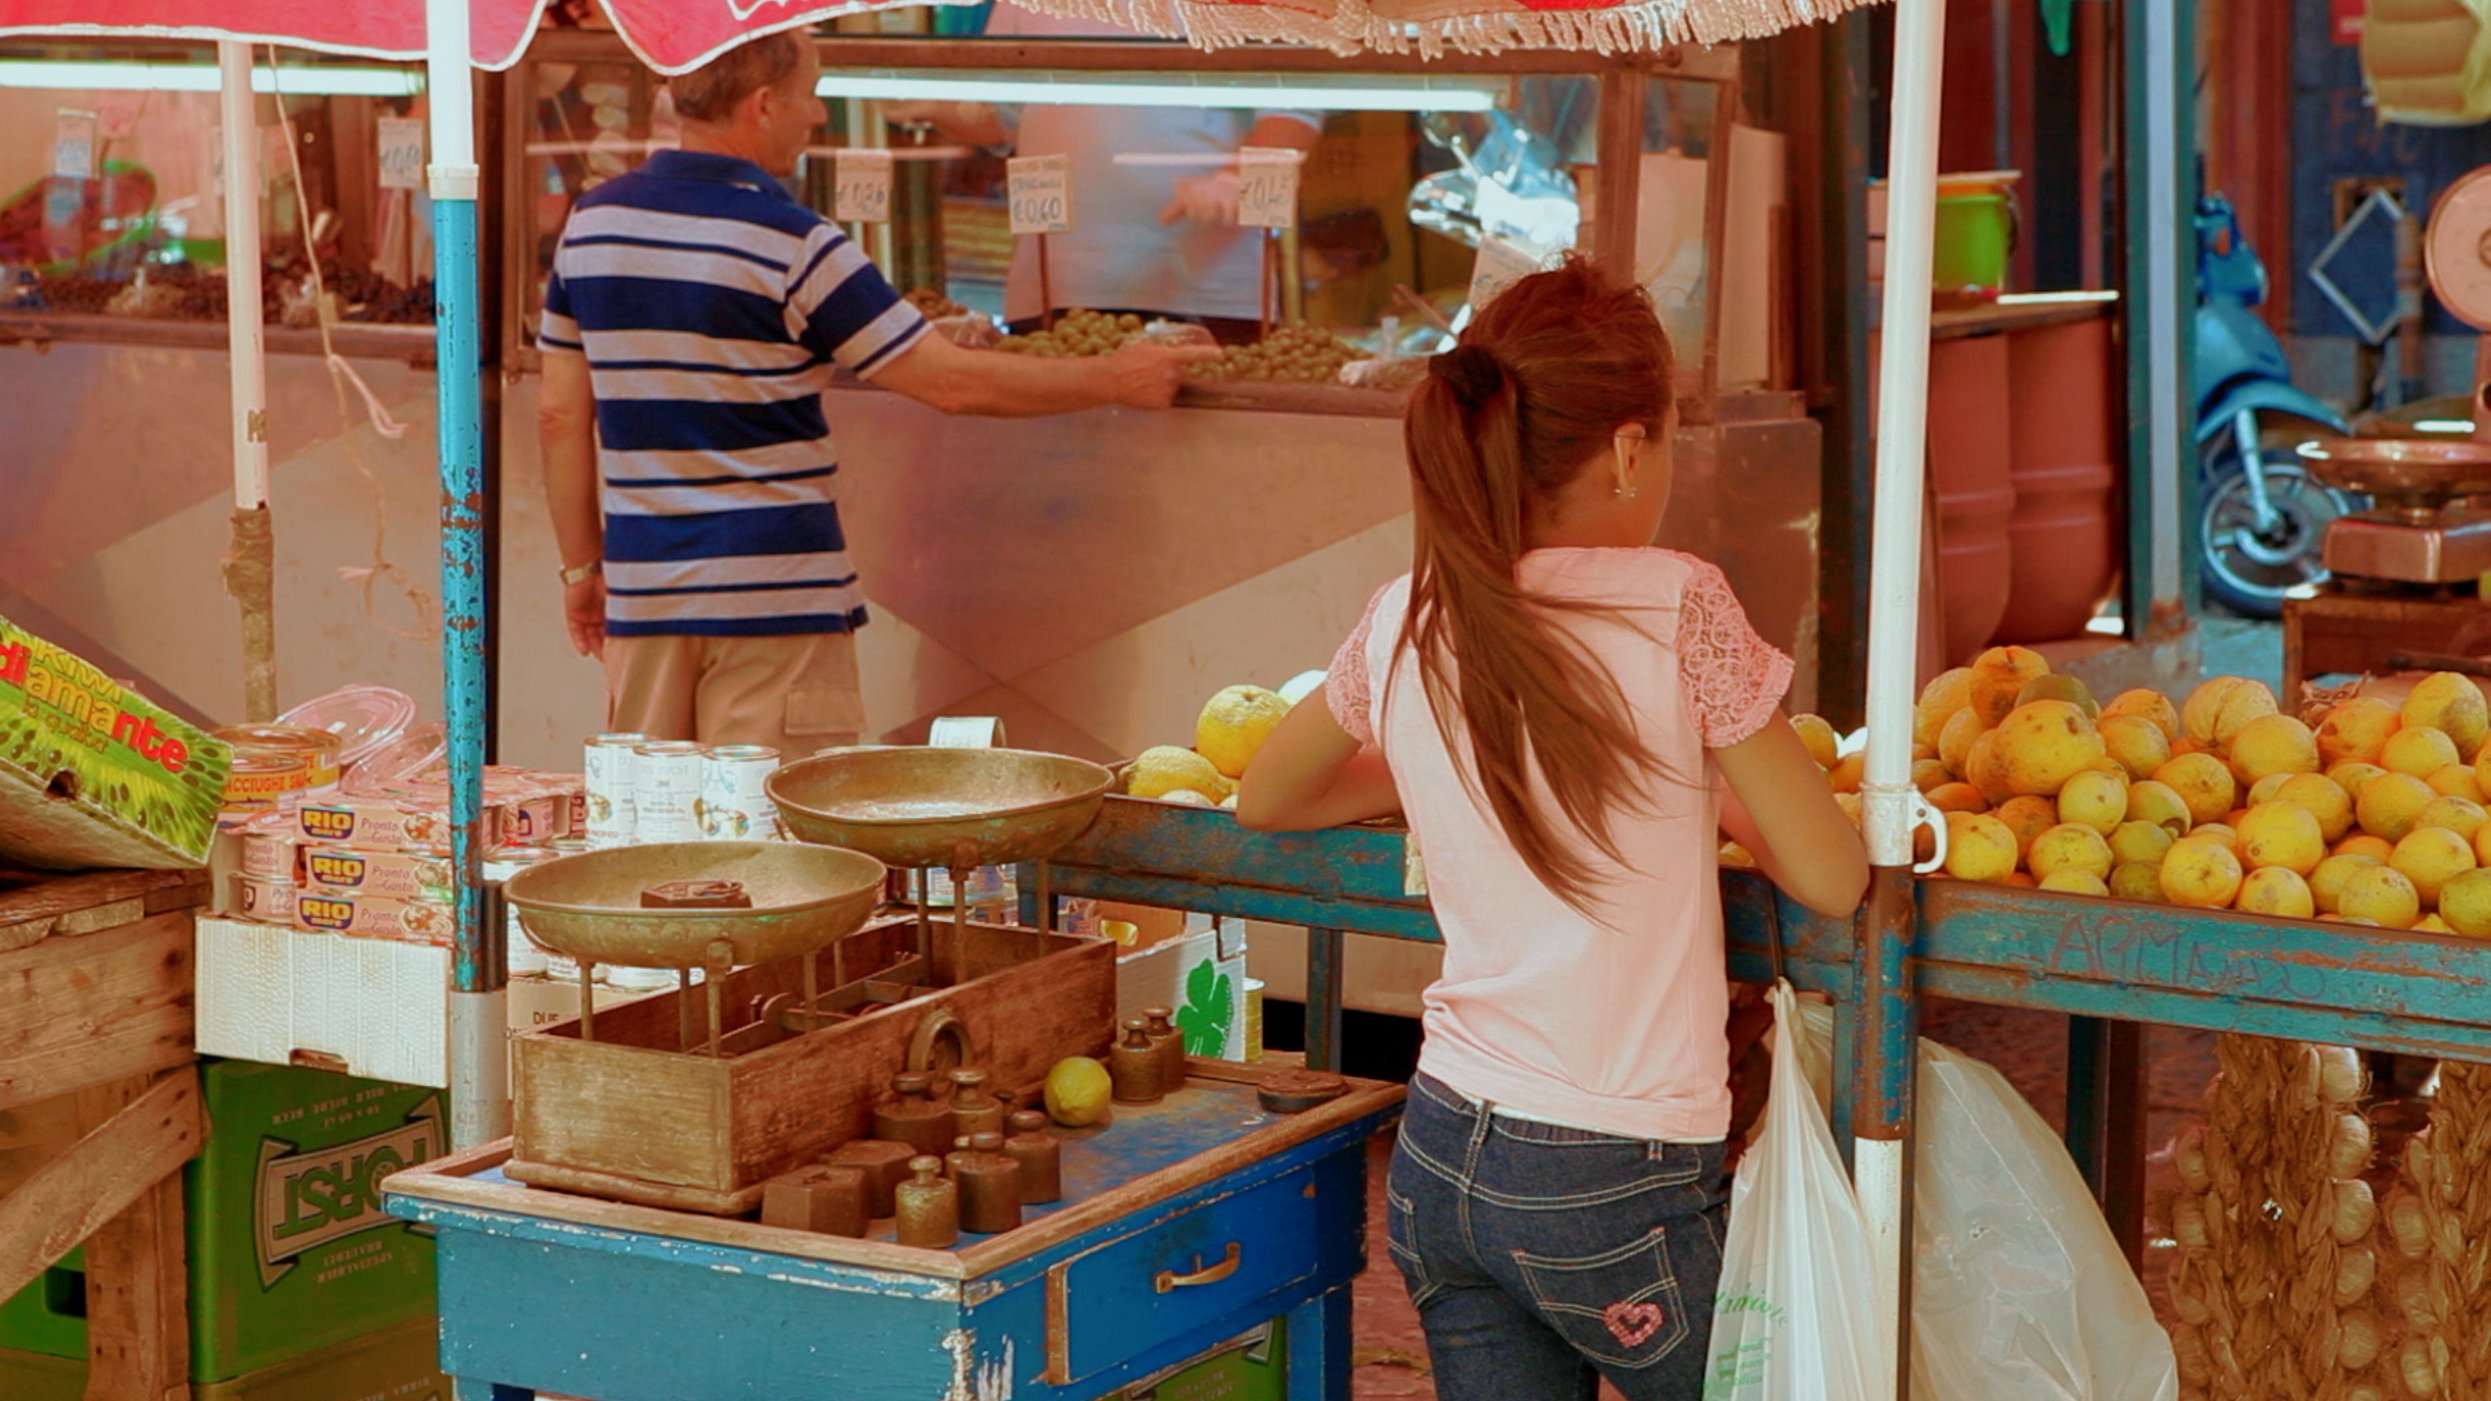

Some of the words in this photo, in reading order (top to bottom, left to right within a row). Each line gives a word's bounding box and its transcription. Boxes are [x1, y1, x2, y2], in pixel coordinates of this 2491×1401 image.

[0, 641, 188, 773] diamante
[304, 810, 353, 830] RIO
[361, 817, 399, 831] Pronto
[314, 857, 363, 878] RIO
[372, 865, 410, 879] Pronto
[302, 900, 352, 920] RIO
[361, 908, 398, 921] Pronto
